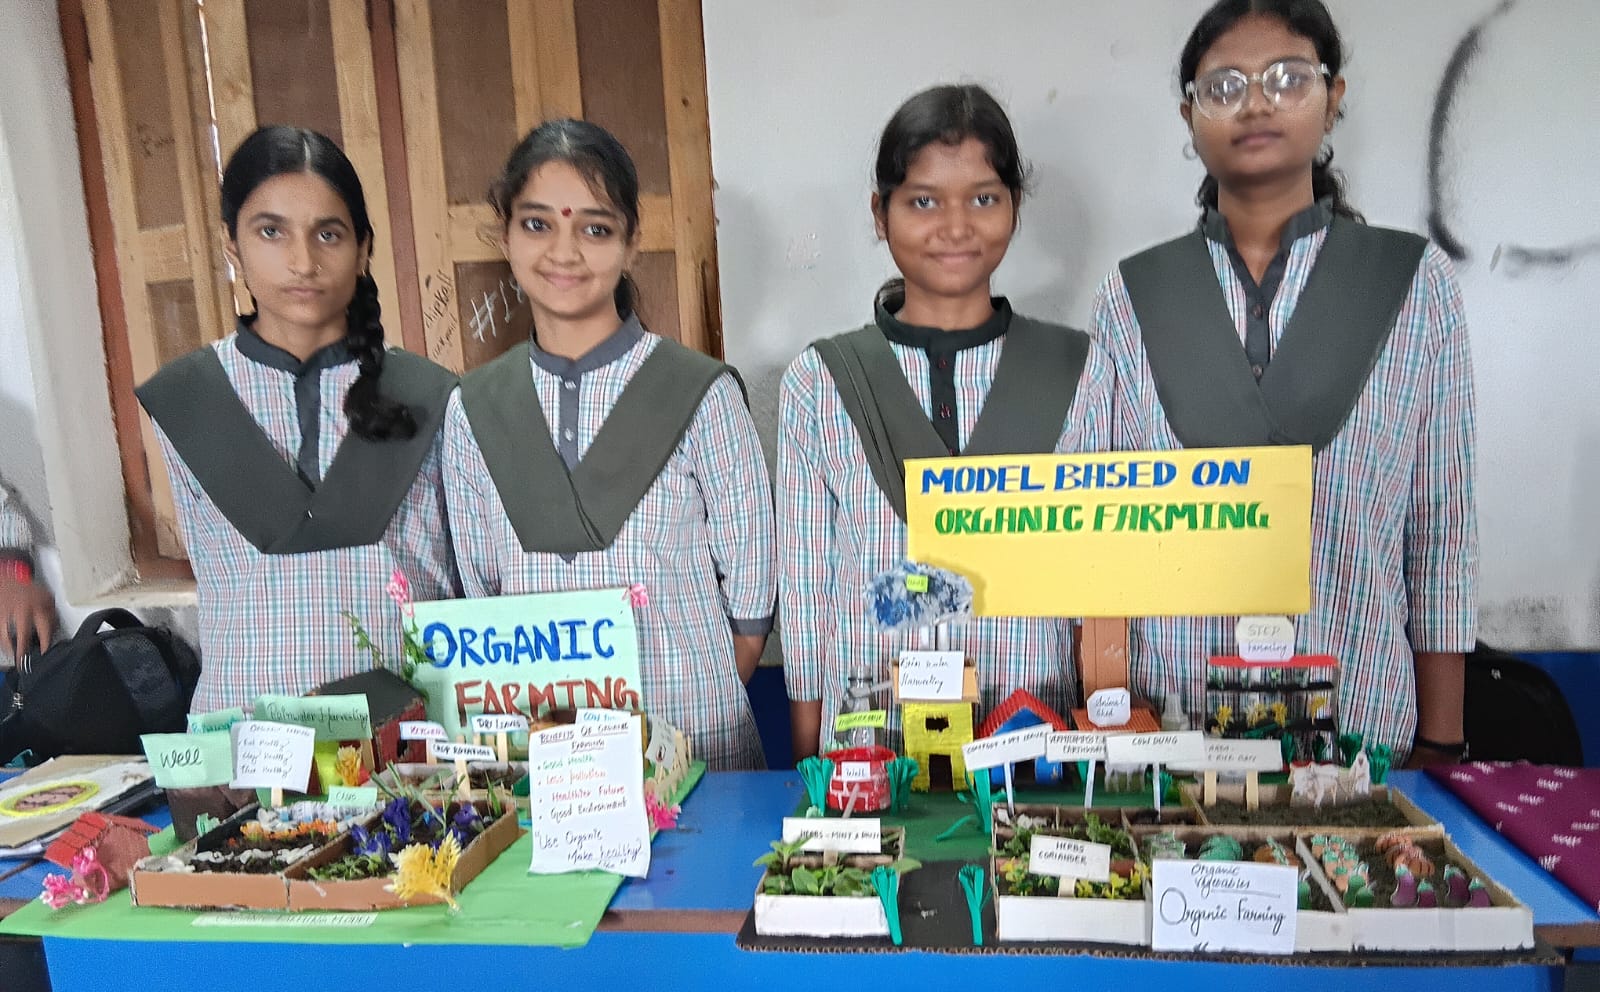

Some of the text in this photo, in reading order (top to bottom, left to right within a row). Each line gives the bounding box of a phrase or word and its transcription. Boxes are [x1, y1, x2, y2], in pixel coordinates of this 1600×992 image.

[921, 459, 1251, 494] MODEL BASED ON
[934, 501, 1270, 534] ORGANIC FARMING
[422, 618, 614, 668] ORGANIC
[455, 675, 640, 727] FARMING
[1153, 735, 1178, 745] DUNG
[160, 748, 204, 769] Well
[1159, 886, 1228, 937] Organic
